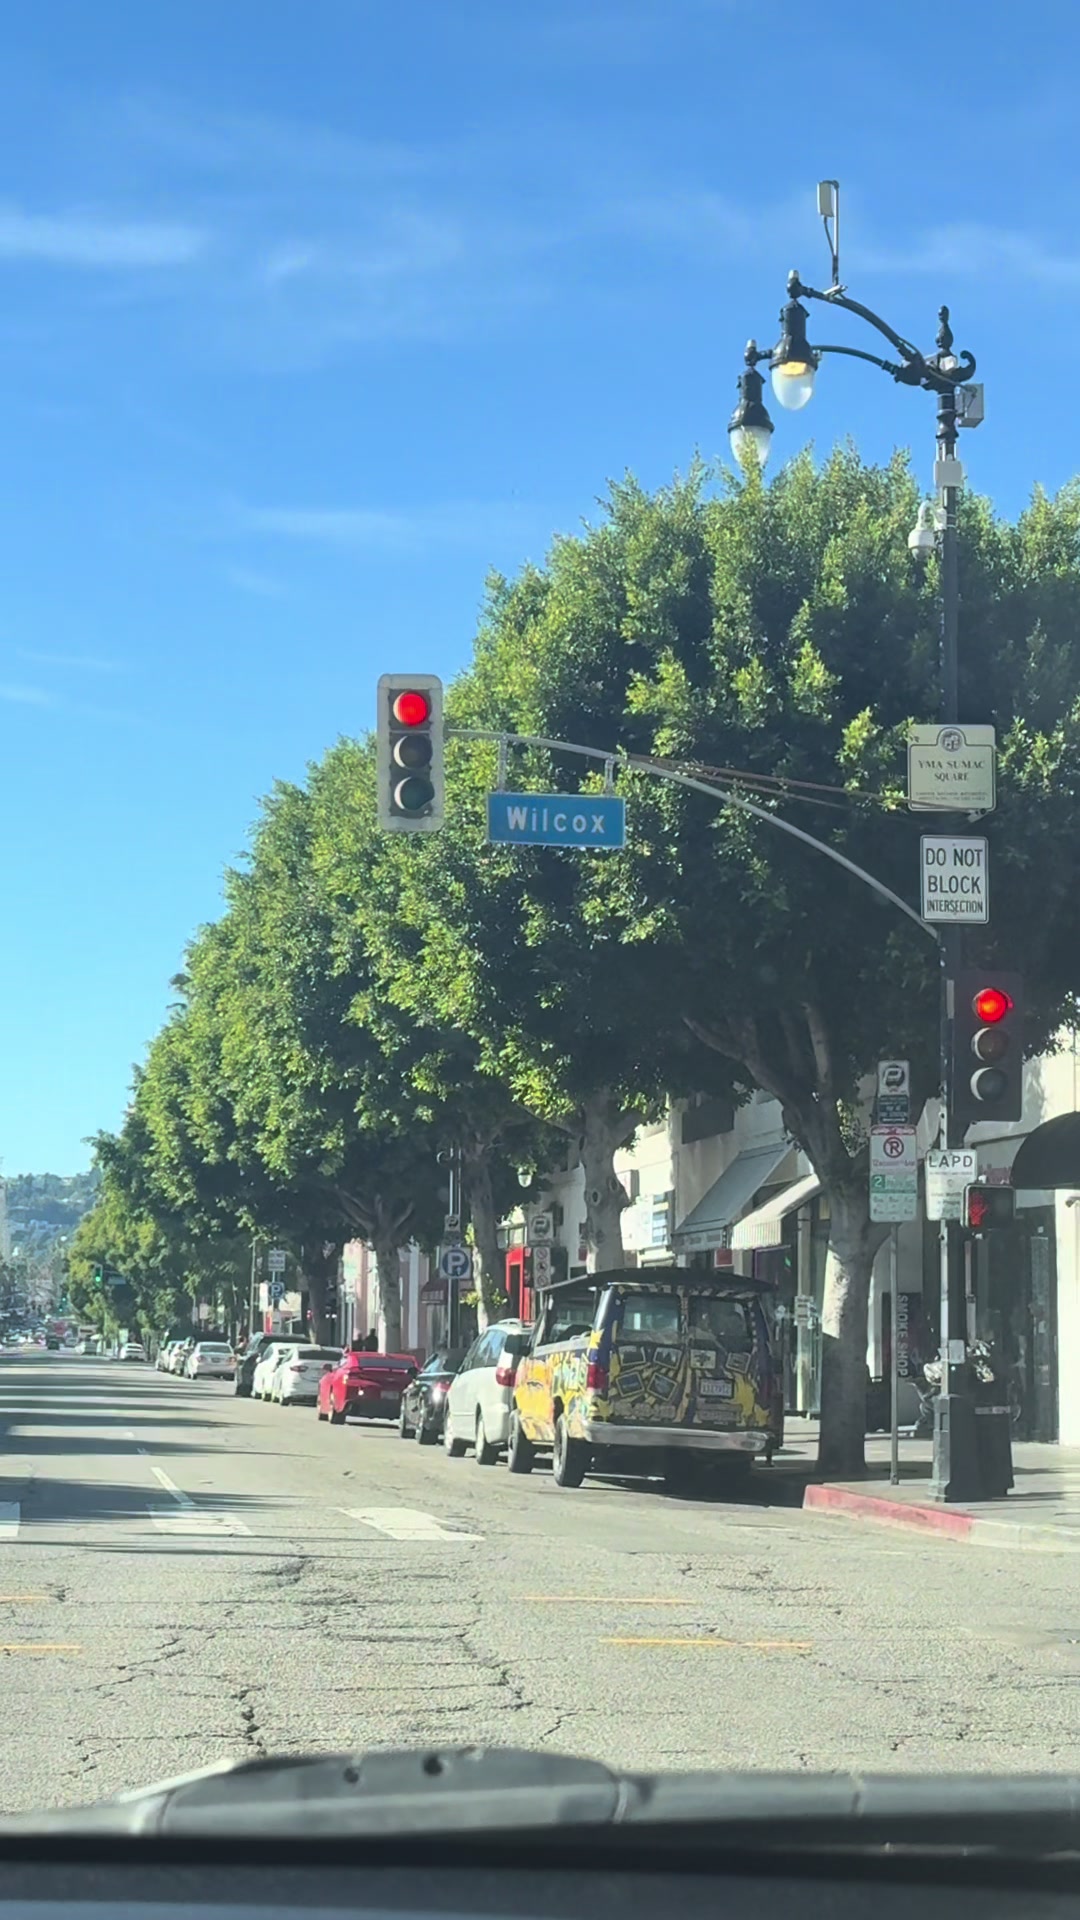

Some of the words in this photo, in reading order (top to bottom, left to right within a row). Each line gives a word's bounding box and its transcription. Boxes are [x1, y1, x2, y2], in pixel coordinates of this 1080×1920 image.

[918, 760, 942, 769] YMA
[946, 760, 986, 769] SUMAC
[934, 773, 969, 782] SQUARE
[506, 806, 606, 834] Wilcox
[925, 848, 946, 867] DO
[953, 848, 983, 867] NOT
[928, 875, 981, 894] BLOCK
[926, 899, 983, 913] INTERSECTION
[929, 1155, 973, 1168] LAPD
[874, 1175, 882, 1188] 2
[897, 1295, 909, 1338] SMOKE
[897, 1342, 909, 1377] SHOP
